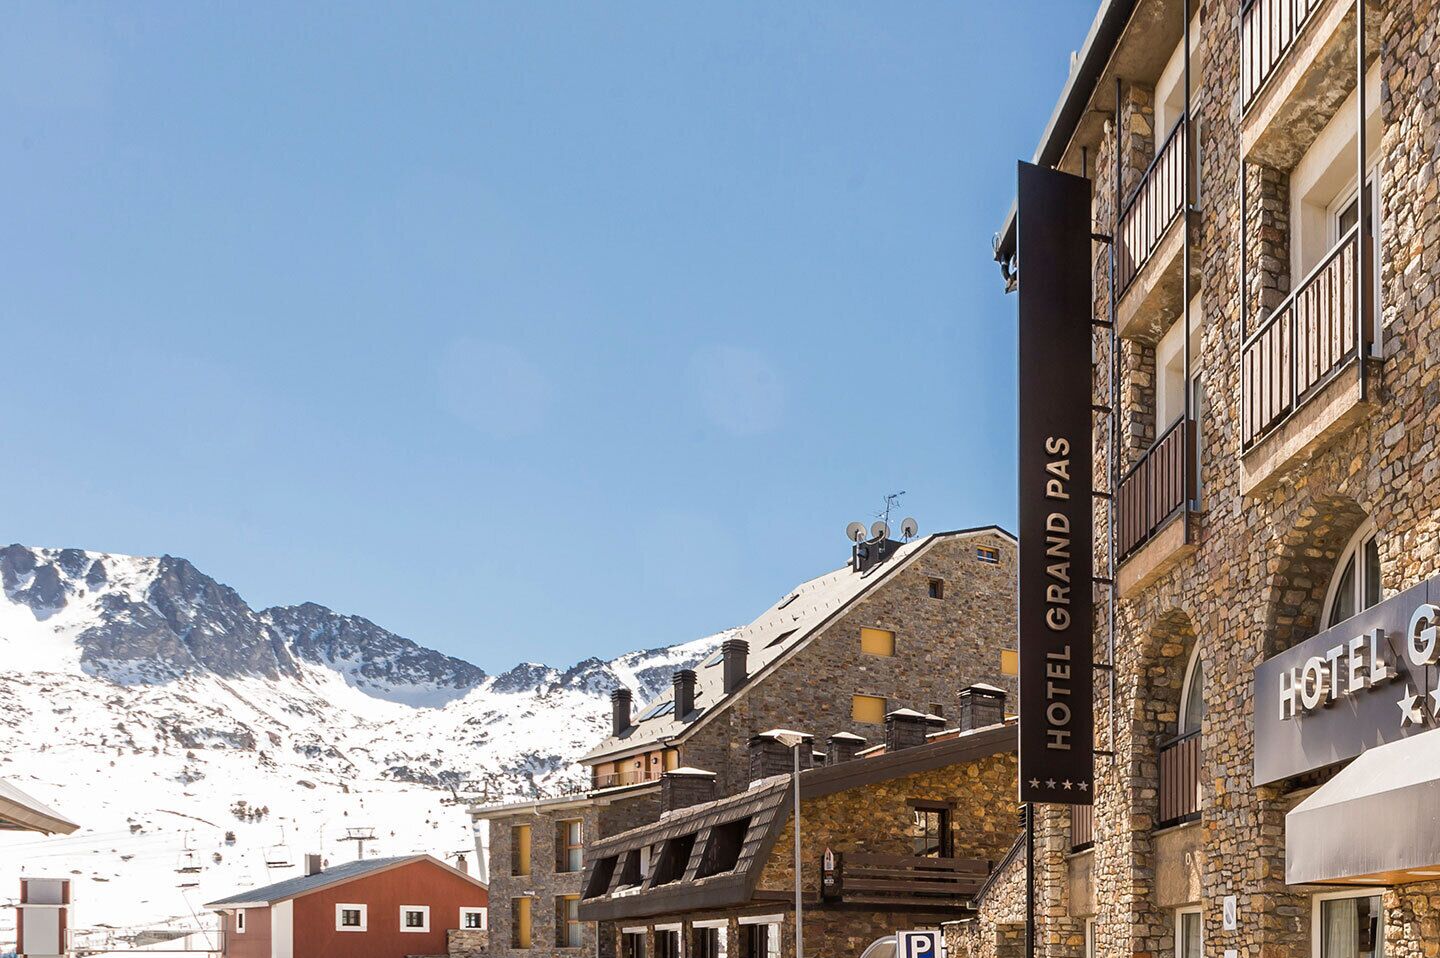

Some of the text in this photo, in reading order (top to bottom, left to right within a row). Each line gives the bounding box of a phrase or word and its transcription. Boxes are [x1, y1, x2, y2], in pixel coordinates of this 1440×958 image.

[1046, 436, 1071, 750] HOTEL GRAND PAS
[1279, 628, 1392, 720] HOTEL
